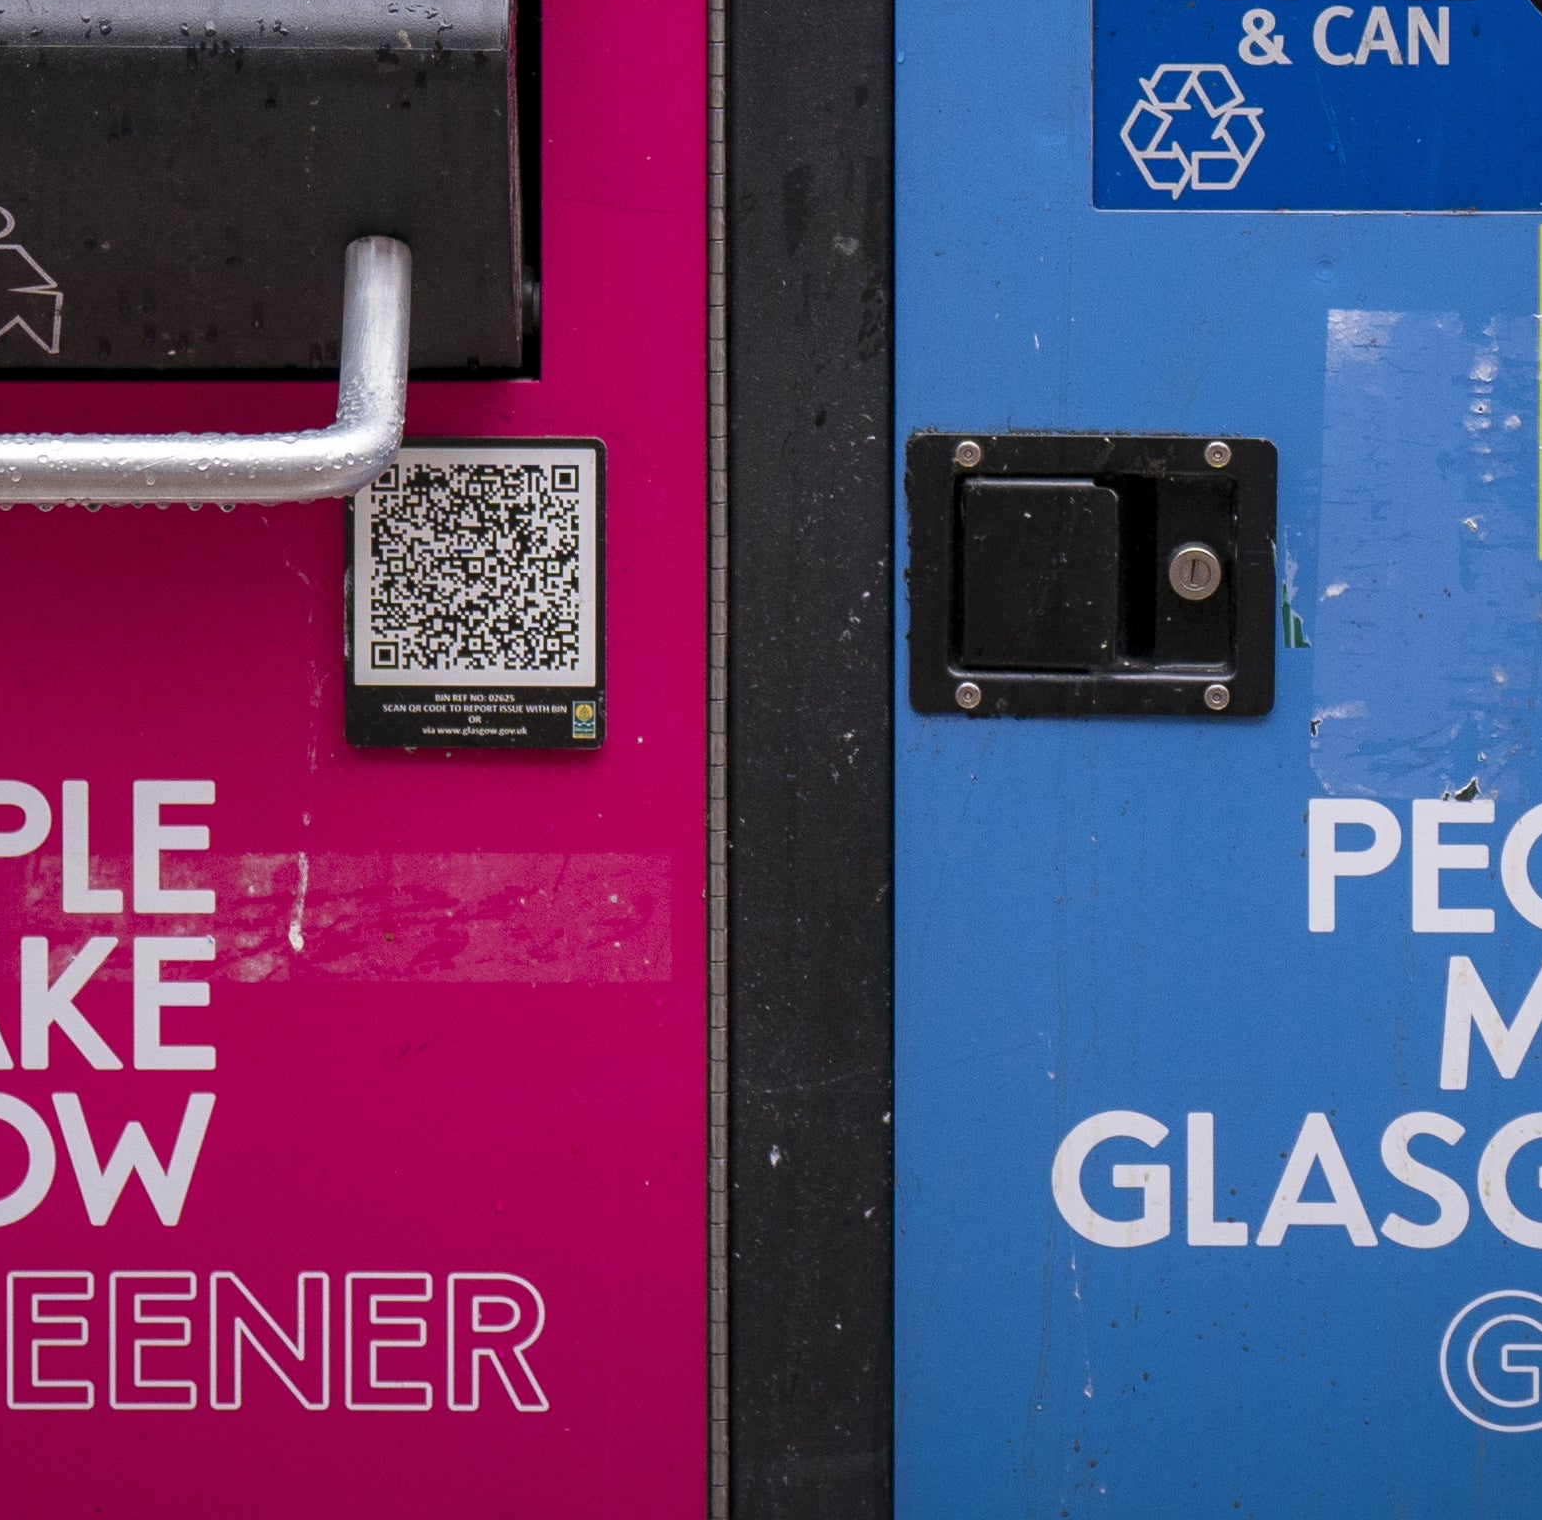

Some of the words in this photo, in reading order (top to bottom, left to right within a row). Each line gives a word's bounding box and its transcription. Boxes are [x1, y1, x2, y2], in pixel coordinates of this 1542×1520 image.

[1238, 8, 1293, 66] &
[1313, 5, 1450, 66] CAN
[434, 694, 451, 702] BIN
[452, 694, 468, 702] REF
[470, 694, 487, 702] NO:
[382, 704, 406, 713] SCAN
[408, 704, 422, 713] QR
[423, 704, 447, 713] CODE
[449, 704, 462, 713] TO
[463, 704, 497, 713] REPORT
[499, 704, 523, 713] ISSUE
[525, 704, 550, 713] WITH
[551, 704, 568, 713] BIN
[468, 715, 482, 724] OR
[422, 726, 436, 736] via
[436, 726, 528, 736] www.glasgow.gov.uk
